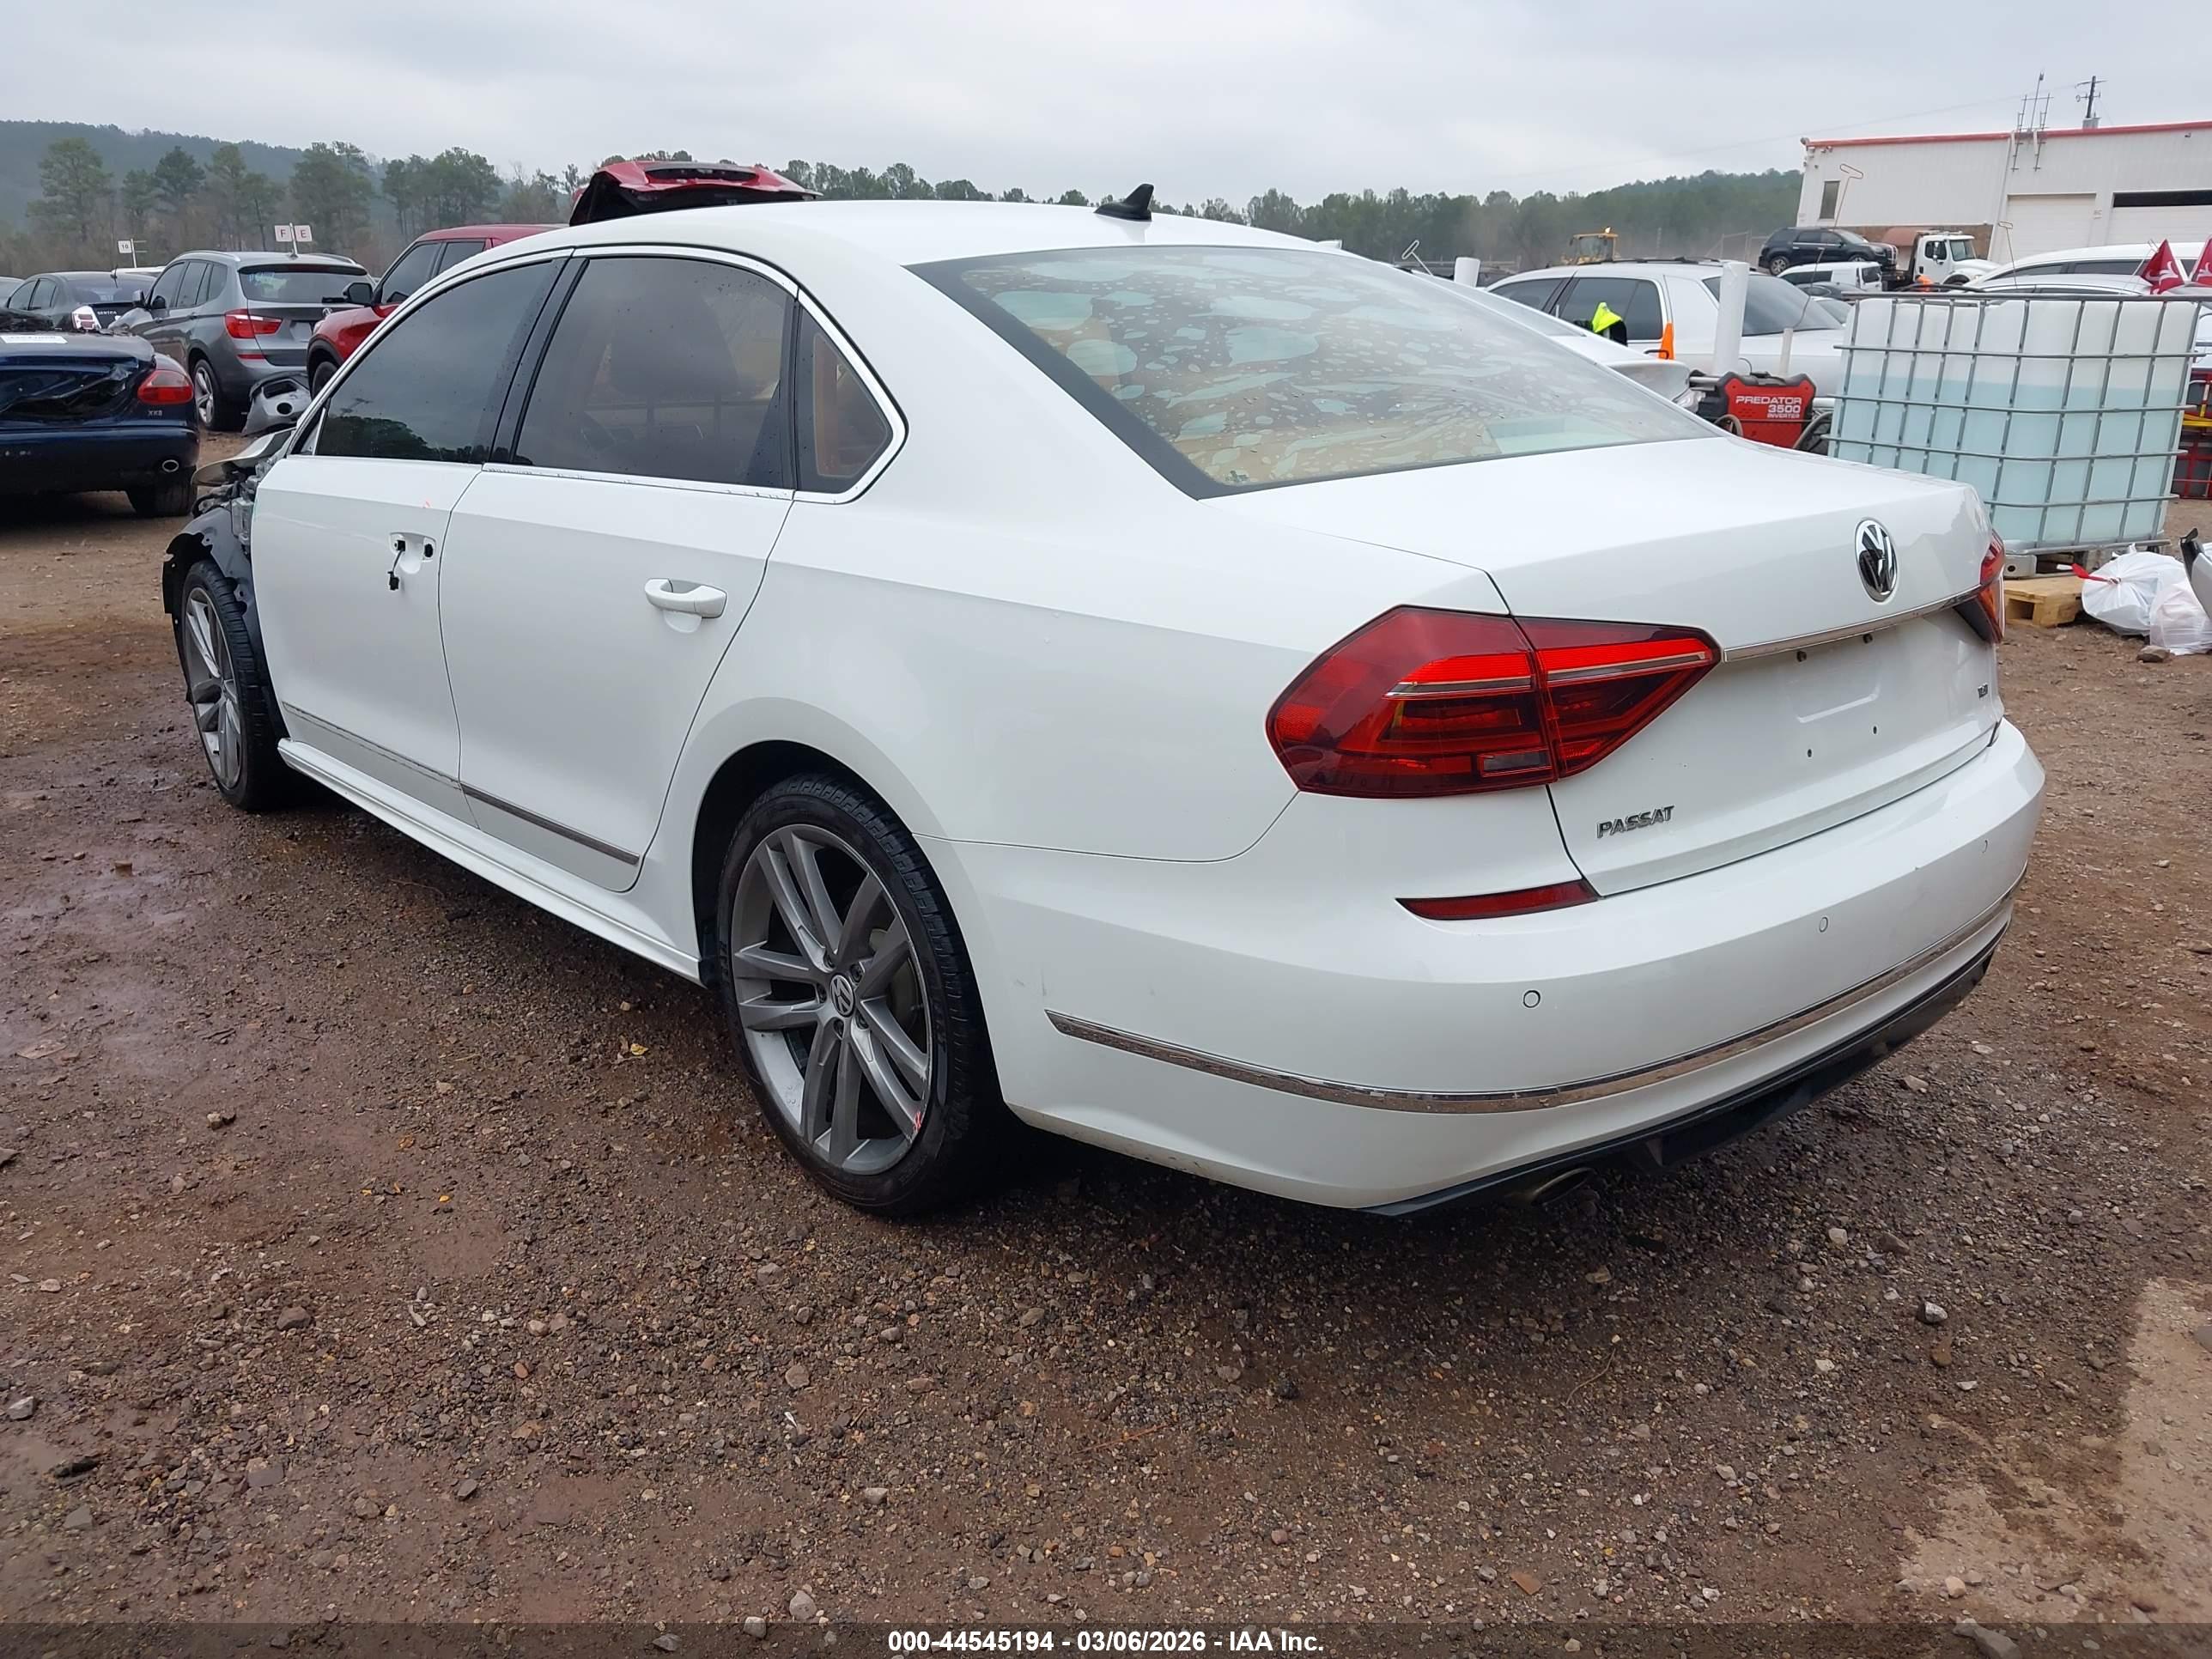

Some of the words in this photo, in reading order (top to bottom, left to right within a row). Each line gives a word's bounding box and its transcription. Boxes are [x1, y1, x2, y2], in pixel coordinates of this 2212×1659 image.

[280, 228, 286, 238] F
[301, 229, 307, 239] E
[1735, 396, 1802, 404] PREDATOR
[1768, 404, 1801, 413] 3500
[1596, 805, 1674, 839] PASSAT
